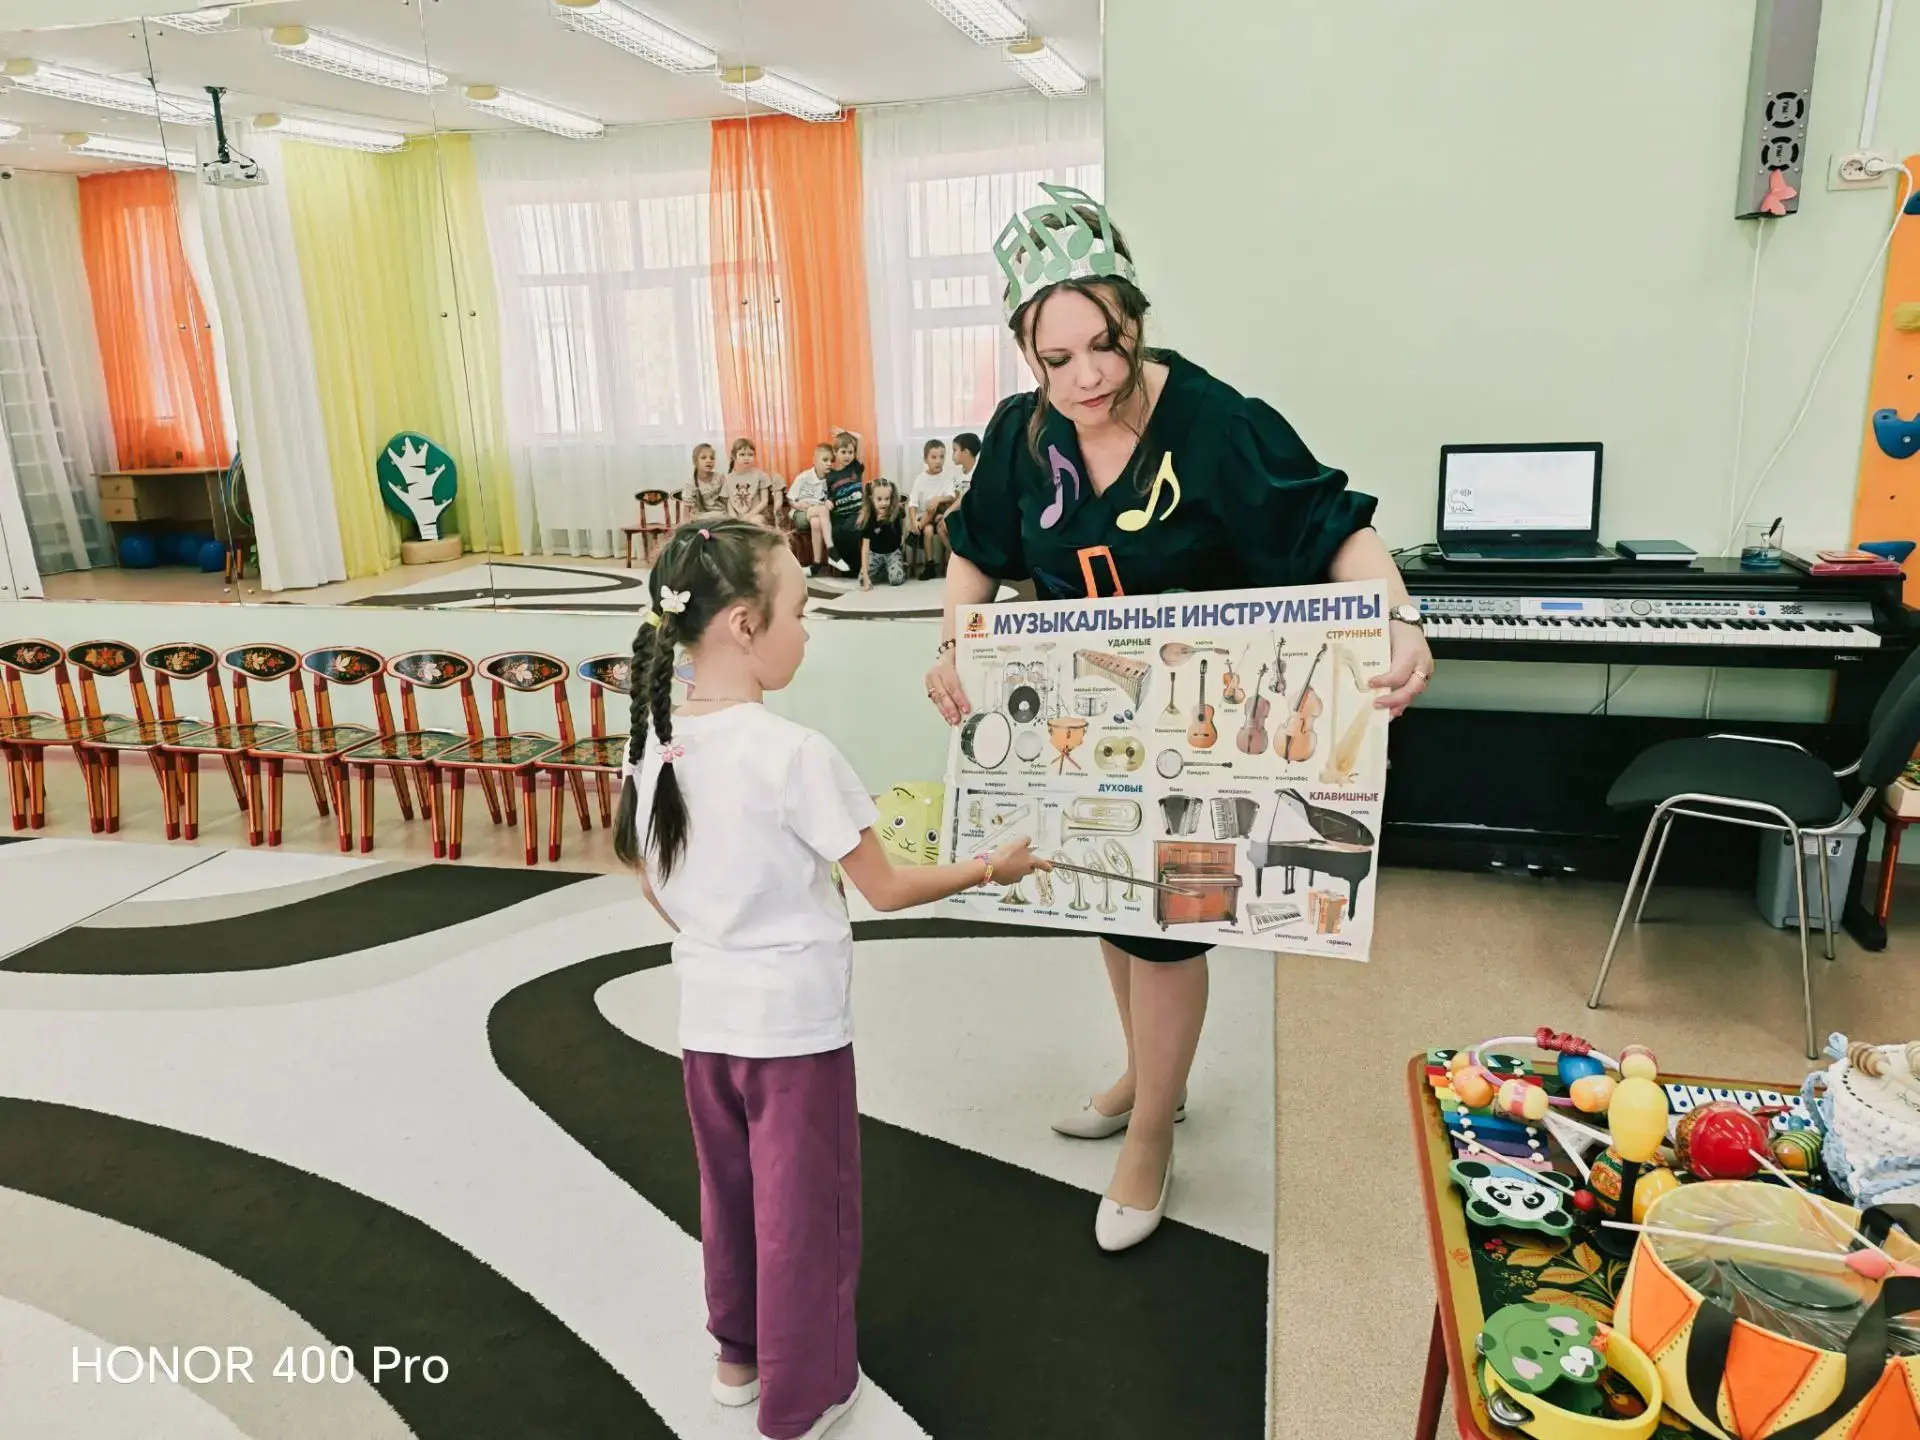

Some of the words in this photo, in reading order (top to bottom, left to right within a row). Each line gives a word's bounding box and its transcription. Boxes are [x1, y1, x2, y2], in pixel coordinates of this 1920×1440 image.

[993, 606, 1176, 635] МУЗЫКАЛЬНЫЕ
[1181, 594, 1380, 628] ИНСТРУМЕНТЫ
[1326, 628, 1382, 640] СТРУННЫЕ
[1107, 638, 1152, 648] УДАРНЫЕ
[1098, 783, 1144, 793] ДУХОВЫЕ
[1309, 791, 1379, 802] КЛАВИШНЫЕ
